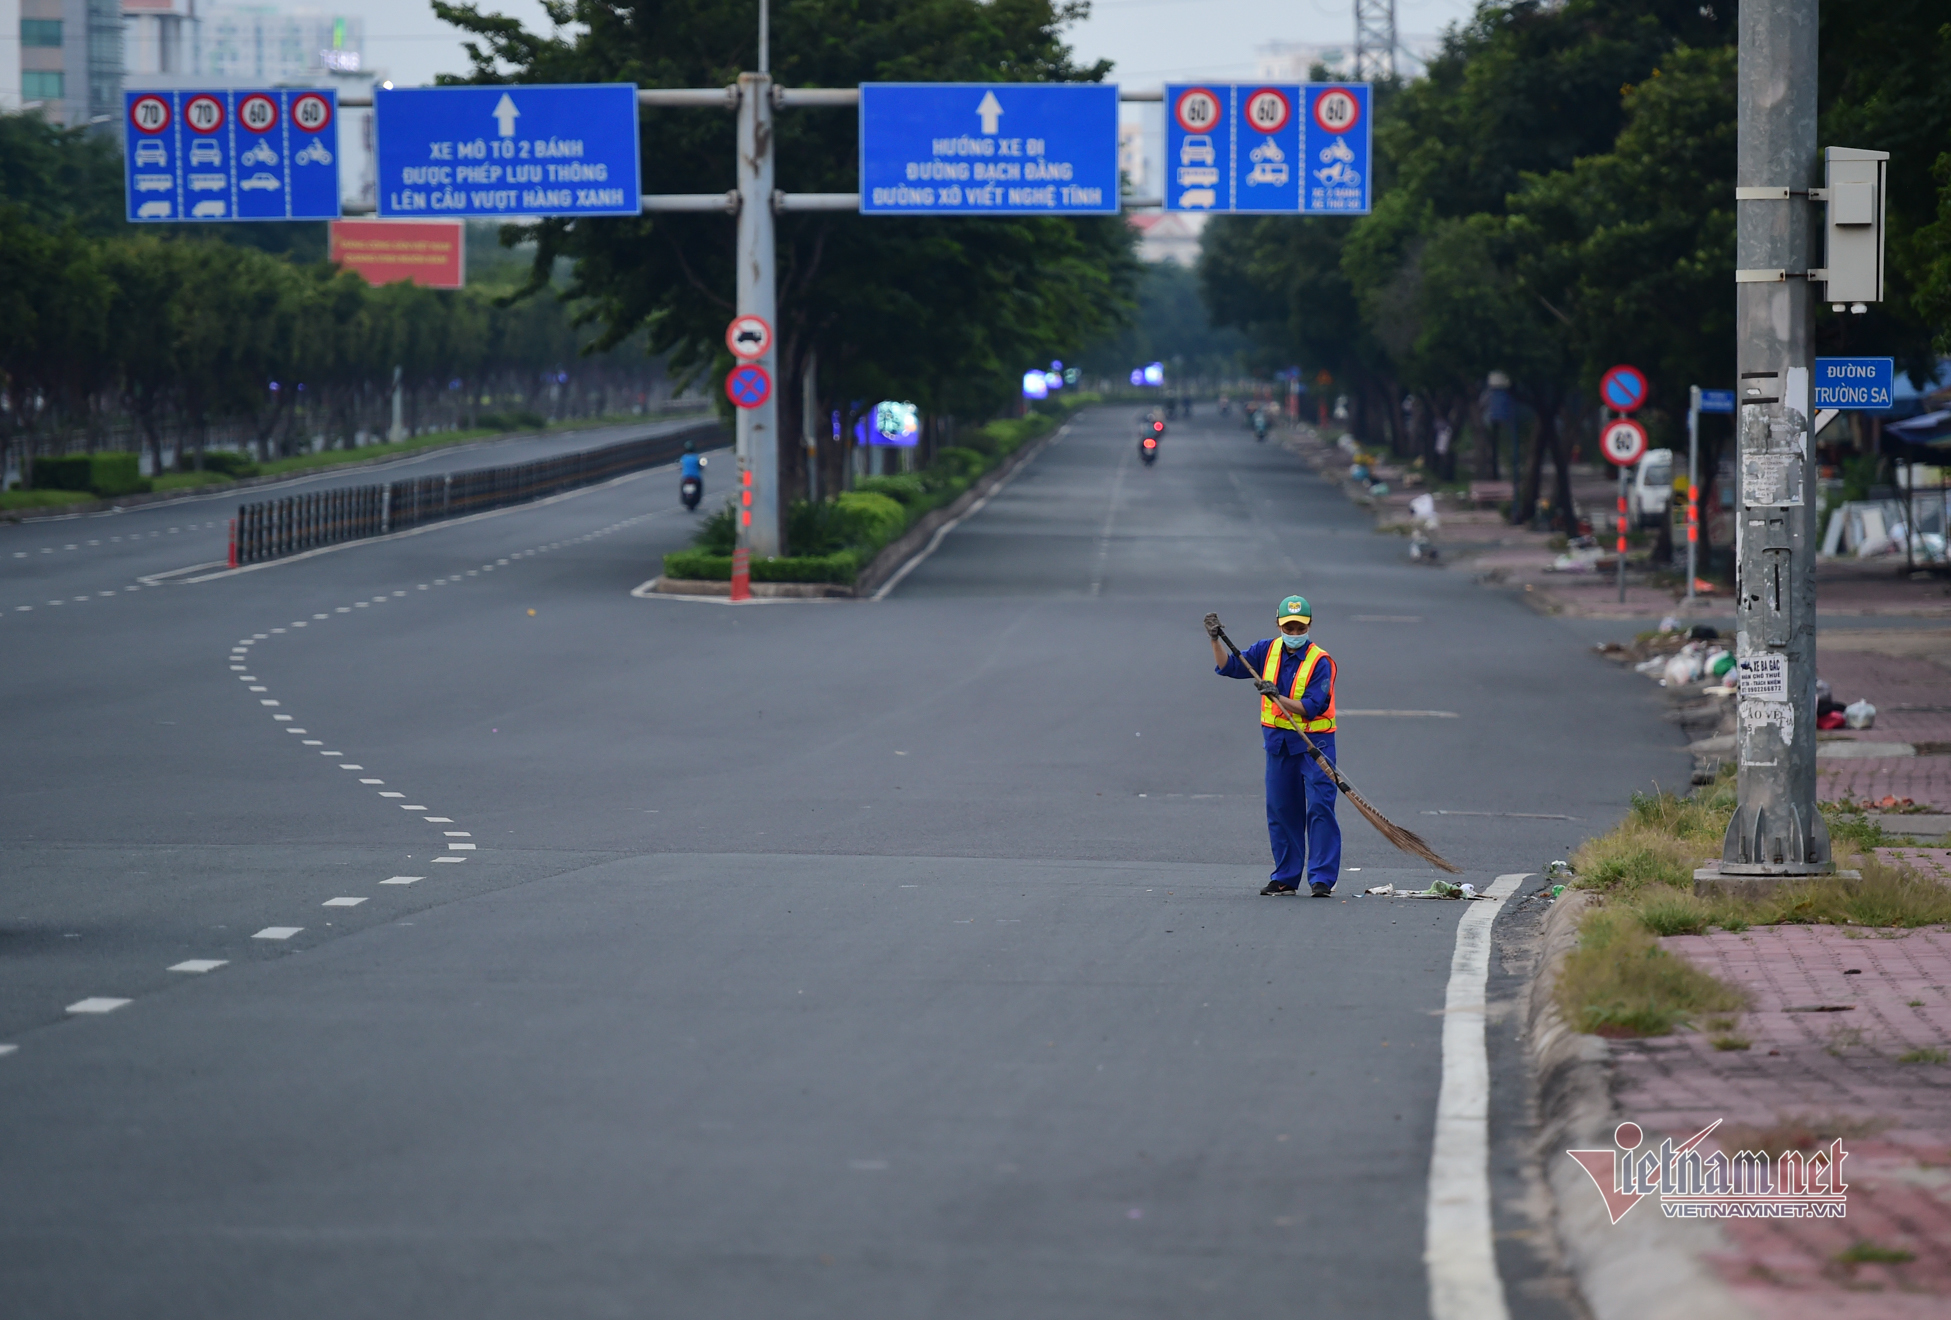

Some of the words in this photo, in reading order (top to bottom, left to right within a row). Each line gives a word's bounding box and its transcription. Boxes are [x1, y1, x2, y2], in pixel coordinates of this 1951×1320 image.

[141, 103, 158, 124] 70
[195, 103, 212, 124] 70
[250, 102, 266, 123] 60
[302, 102, 319, 122] 60
[1187, 98, 1209, 121] 60
[1257, 98, 1278, 121] 60
[1326, 98, 1347, 120] 60
[429, 141, 453, 160] XE
[457, 138, 486, 159] MÔ
[490, 137, 515, 159] TÔ
[518, 141, 531, 159] 2
[534, 136, 584, 158] BÁNH
[932, 134, 995, 157] HƯỚNG
[998, 138, 1022, 157] XE
[1026, 138, 1045, 157] ĐI
[402, 165, 452, 187] ĐƯỢC
[456, 161, 502, 183] PHÉP
[506, 164, 543, 183] LƯU
[547, 161, 608, 182] THÔNG
[906, 158, 970, 181] ĐƯỜNG
[391, 189, 427, 210] LÊN
[431, 185, 466, 209] CẦU
[471, 189, 518, 212] VƯỢT
[522, 186, 572, 208] HÀNG
[576, 188, 624, 207] XANH
[872, 182, 935, 206] ĐƯỜNG
[938, 184, 962, 206] XÔ
[965, 181, 1005, 206] VIẾT
[1008, 185, 1057, 209] NGHỆ
[1060, 184, 1102, 206] TĨNH
[1827, 363, 1876, 378] ĐƯỜNG
[1815, 382, 1868, 403] TRƯỜNG
[1871, 387, 1889, 403] SA
[1614, 431, 1633, 451] 60
[1754, 661, 1759, 671] XE
[1761, 660, 1768, 671] BA
[1769, 657, 1780, 671] GÁC
